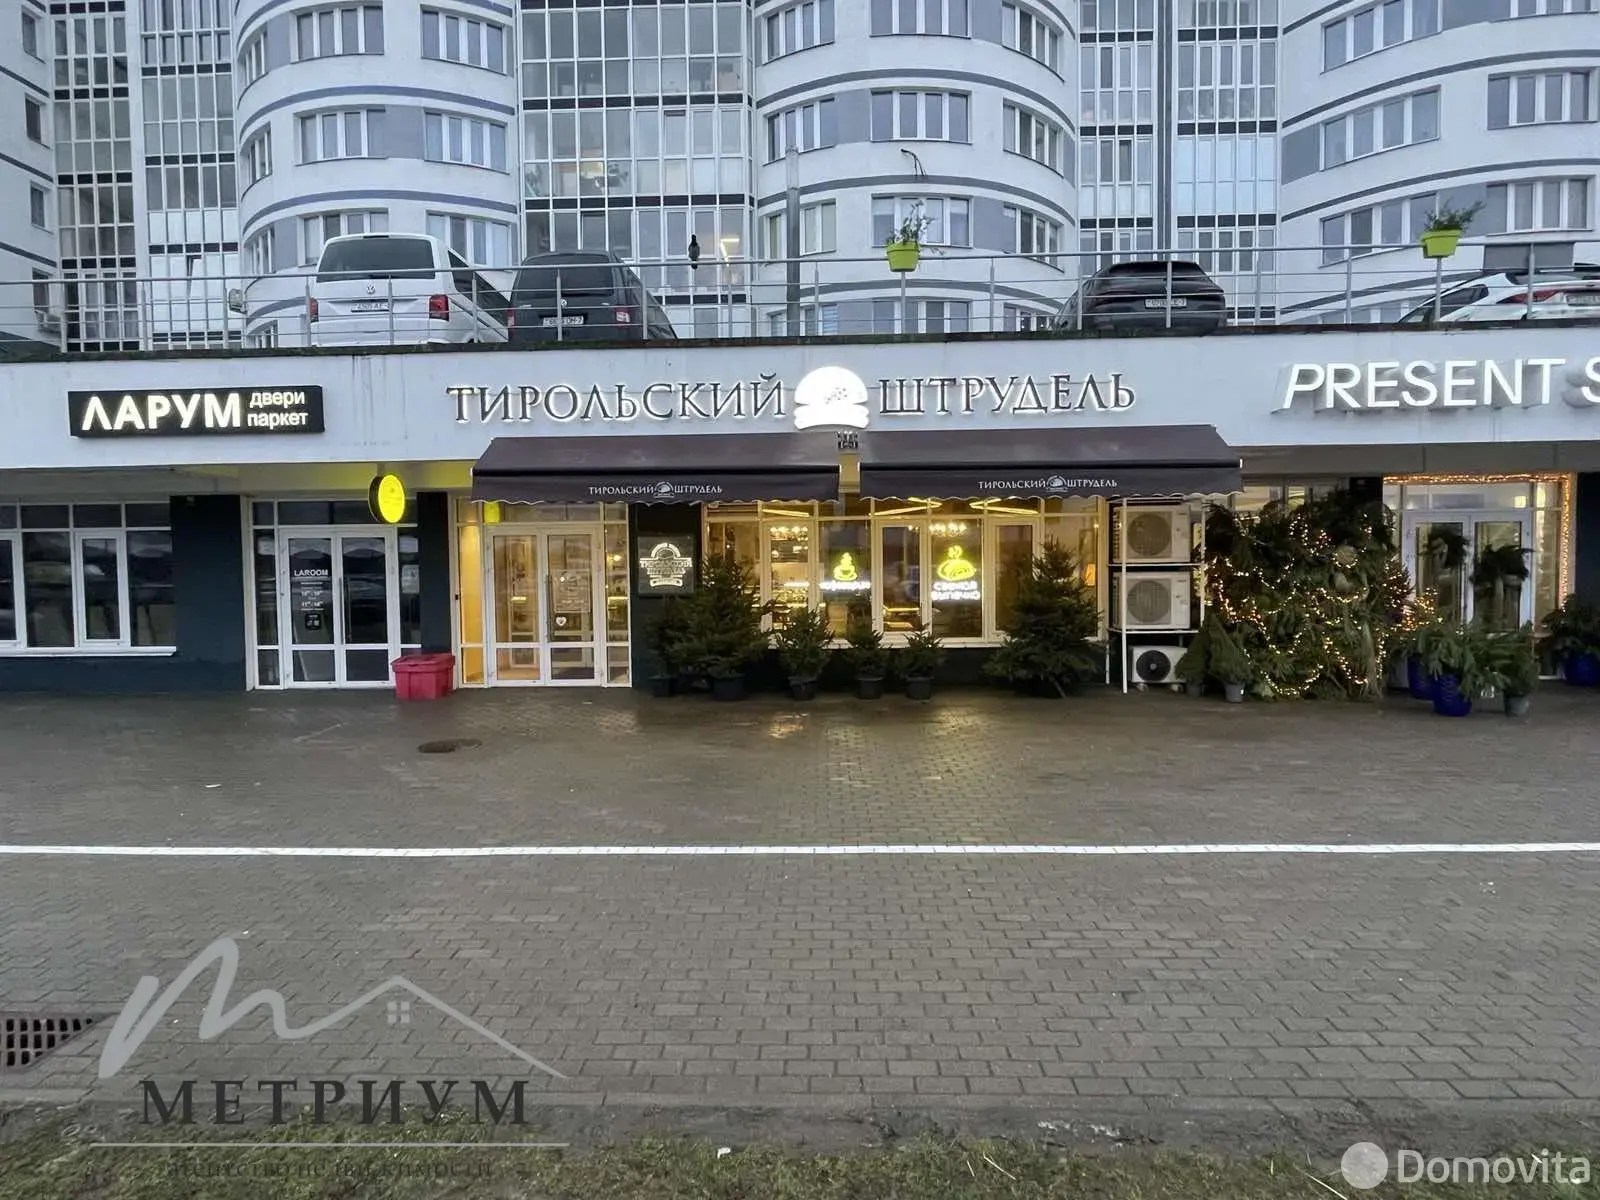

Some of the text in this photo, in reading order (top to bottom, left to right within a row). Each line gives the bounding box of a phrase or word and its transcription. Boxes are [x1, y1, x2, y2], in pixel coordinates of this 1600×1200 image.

[1282, 357, 1567, 410] PRESENT
[249, 391, 306, 409] двери
[446, 372, 1136, 424] ТИРОЛЬСКИЙ ШТРУДЕЛЬ
[81, 392, 241, 431] ЛАРУМ
[247, 411, 308, 430] паркет
[588, 484, 723, 495] ТИРОЛЬСКИЙ ШТРУДЕЛЬ
[978, 478, 1118, 489] ТИРОЛЬСКИЙ ШТРУДЕЛЬ
[294, 569, 329, 577] LAROOM
